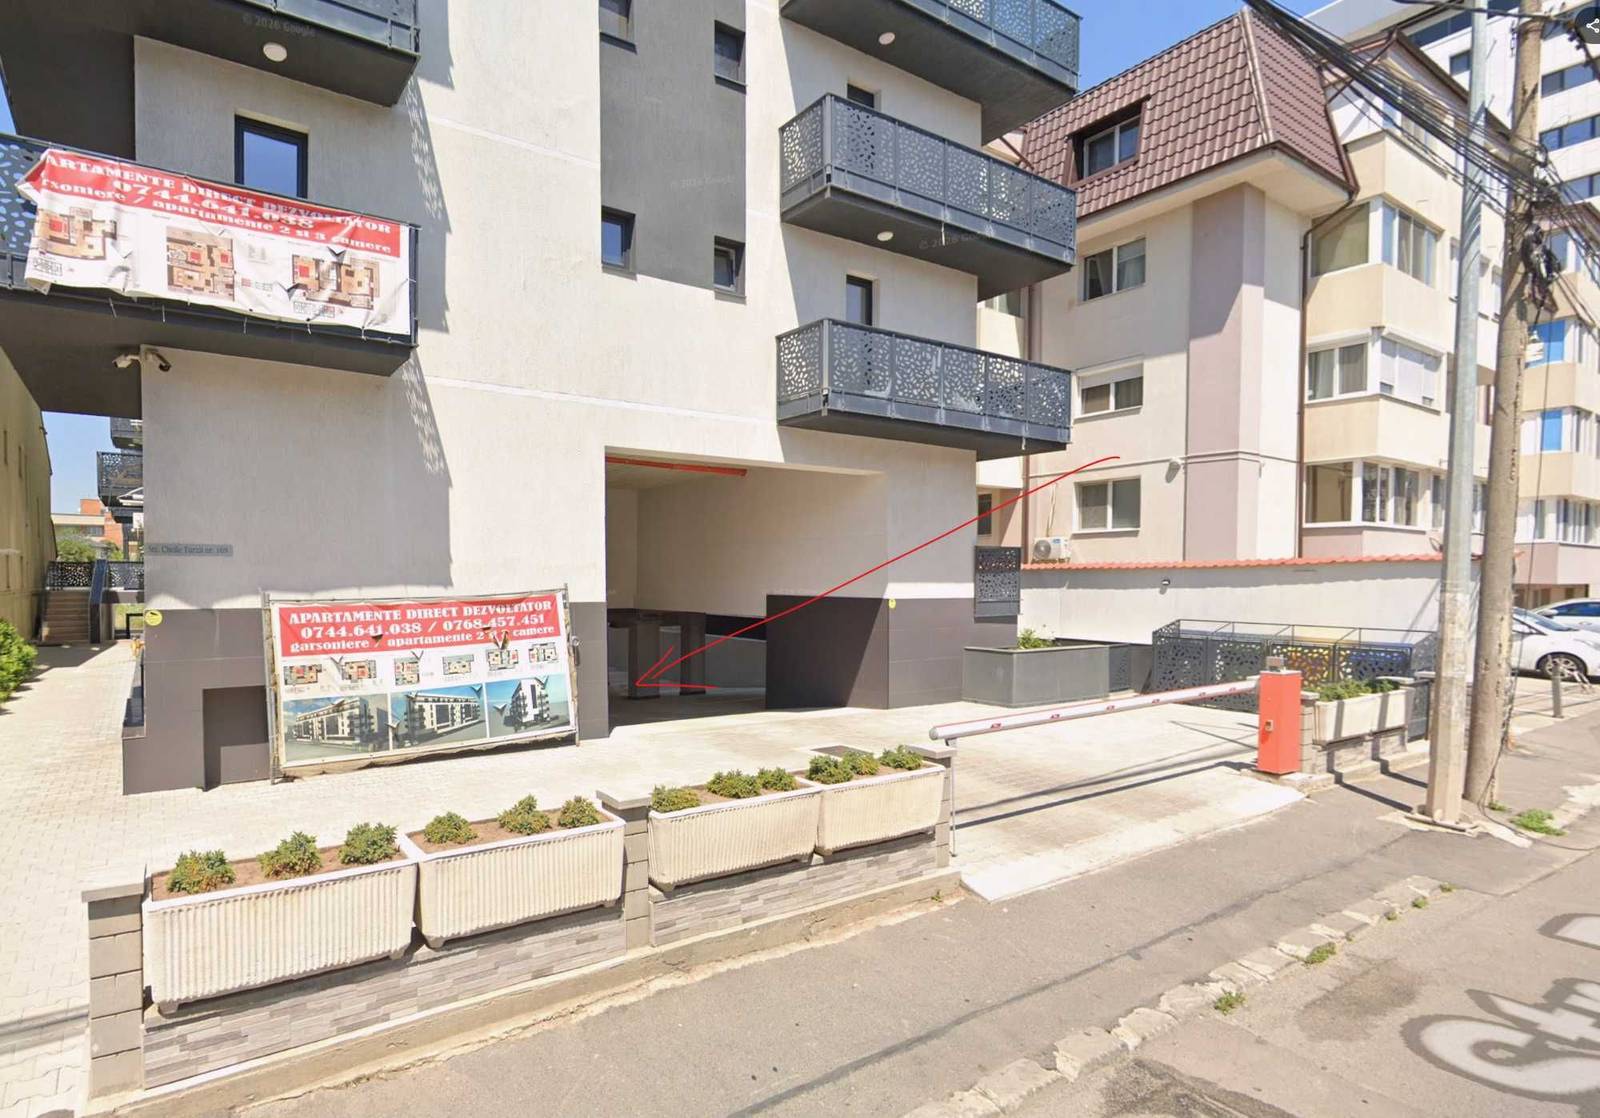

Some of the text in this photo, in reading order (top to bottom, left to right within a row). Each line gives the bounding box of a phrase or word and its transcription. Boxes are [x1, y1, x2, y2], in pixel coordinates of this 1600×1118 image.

[152, 200, 273, 232] apartamente
[280, 225, 291, 234] 2
[289, 600, 552, 625] APARTAMENTE DIRECT DEZVOLTATOR
[290, 637, 370, 653] garsoniere
[387, 632, 472, 648] apartamente
[512, 626, 555, 637] camere
[300, 621, 422, 640] 0744.641.038
[442, 613, 545, 632] 0768.457.451
